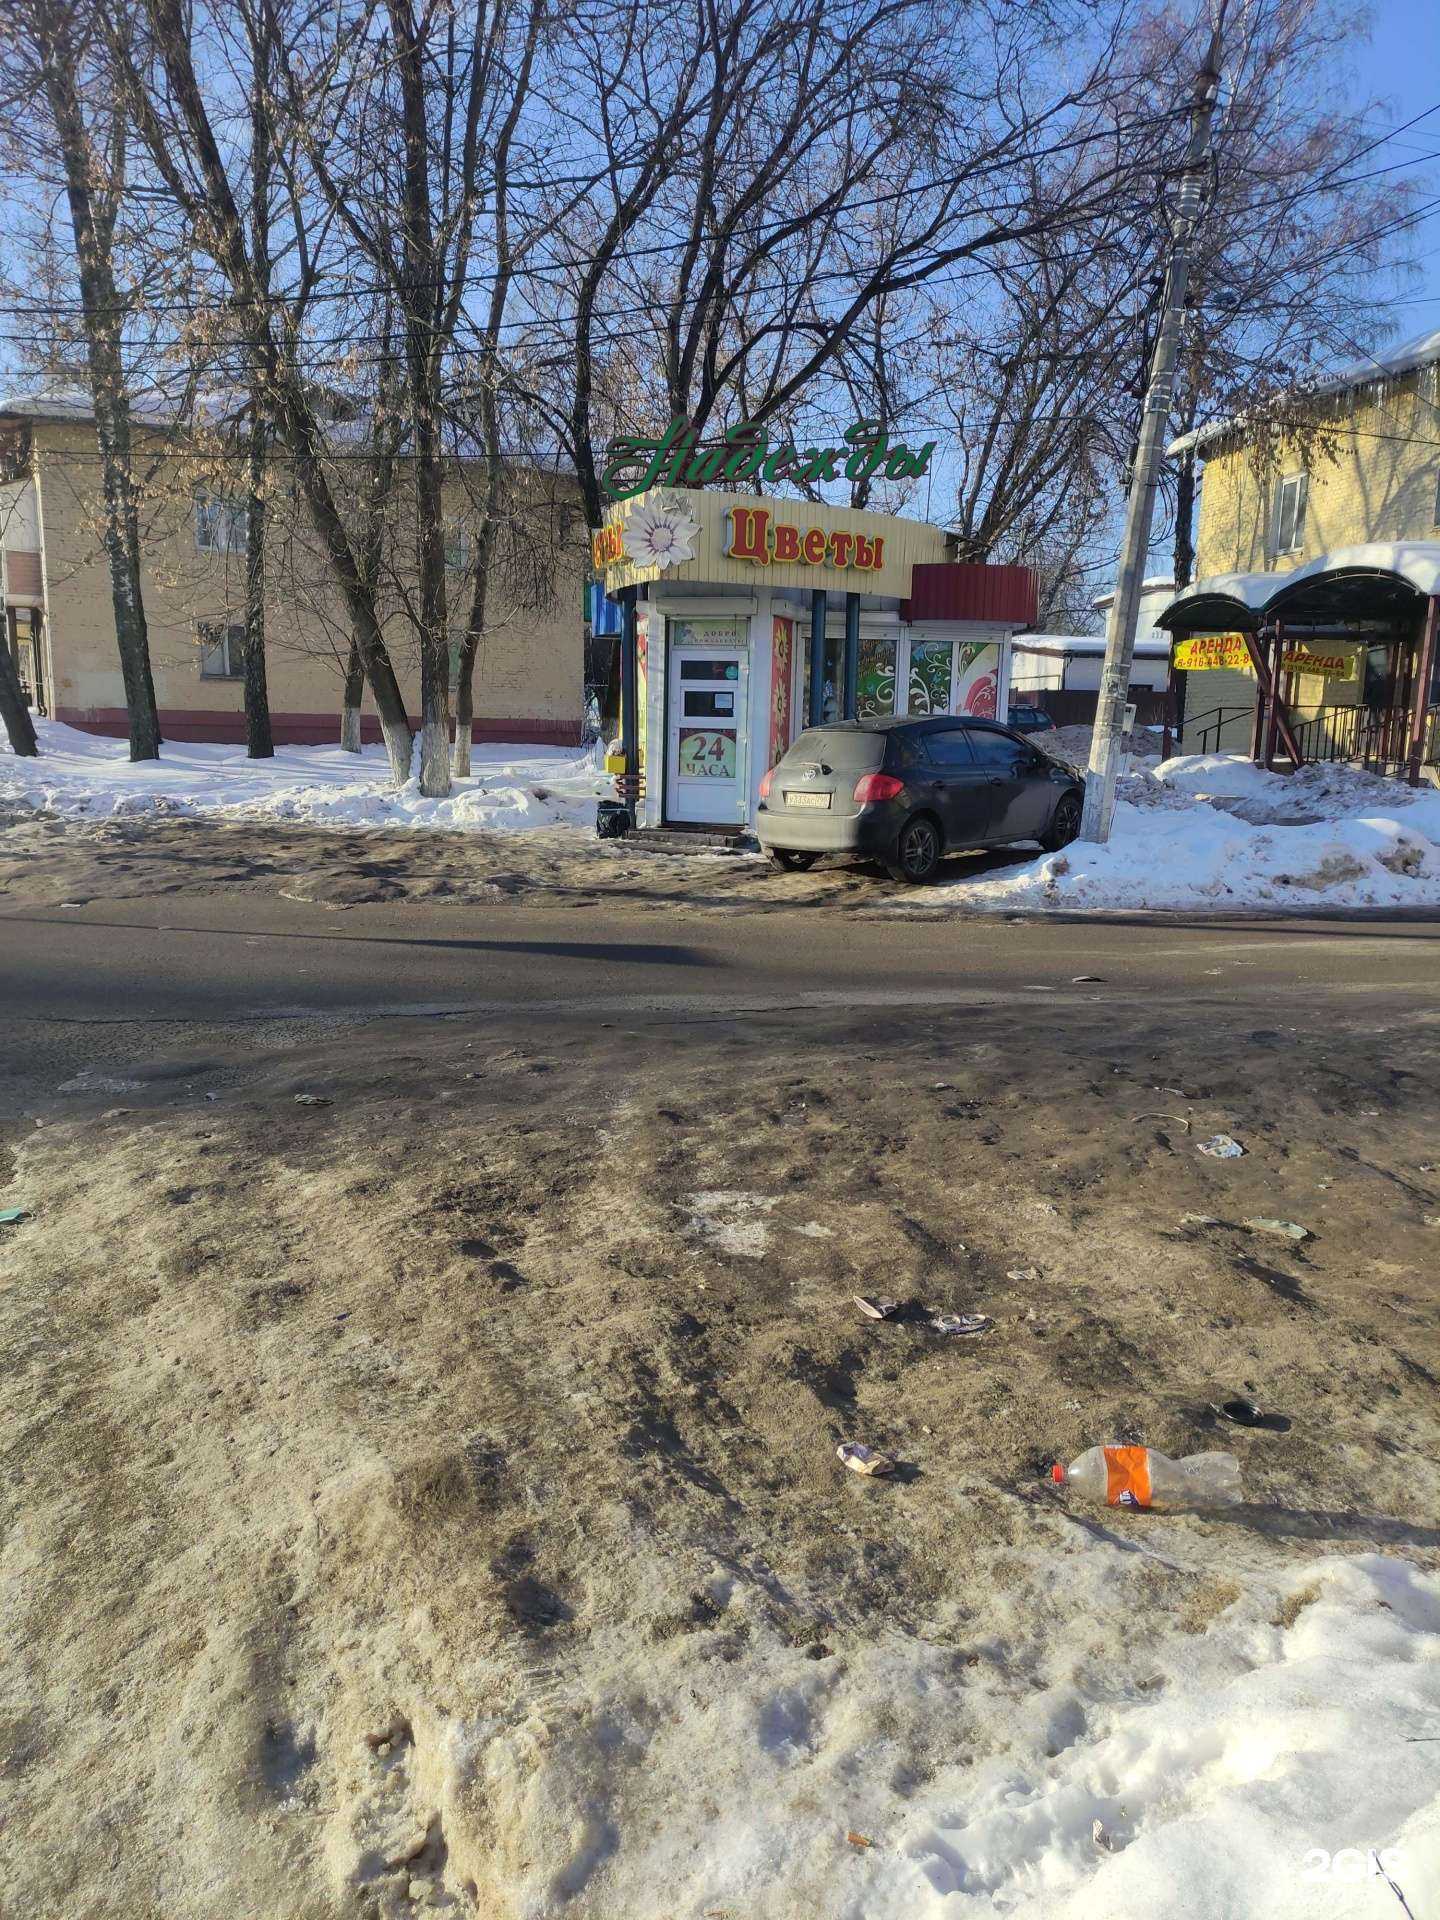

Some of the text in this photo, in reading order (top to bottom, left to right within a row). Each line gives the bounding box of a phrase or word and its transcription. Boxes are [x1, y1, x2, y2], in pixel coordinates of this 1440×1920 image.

[604, 416, 938, 500] Надежды
[730, 507, 885, 571] Цветы
[1191, 636, 1242, 656] АРЕНДА
[1284, 652, 1345, 670] АРЕНДА
[692, 736, 726, 761] 24
[686, 763, 731, 777] ЧАСА
